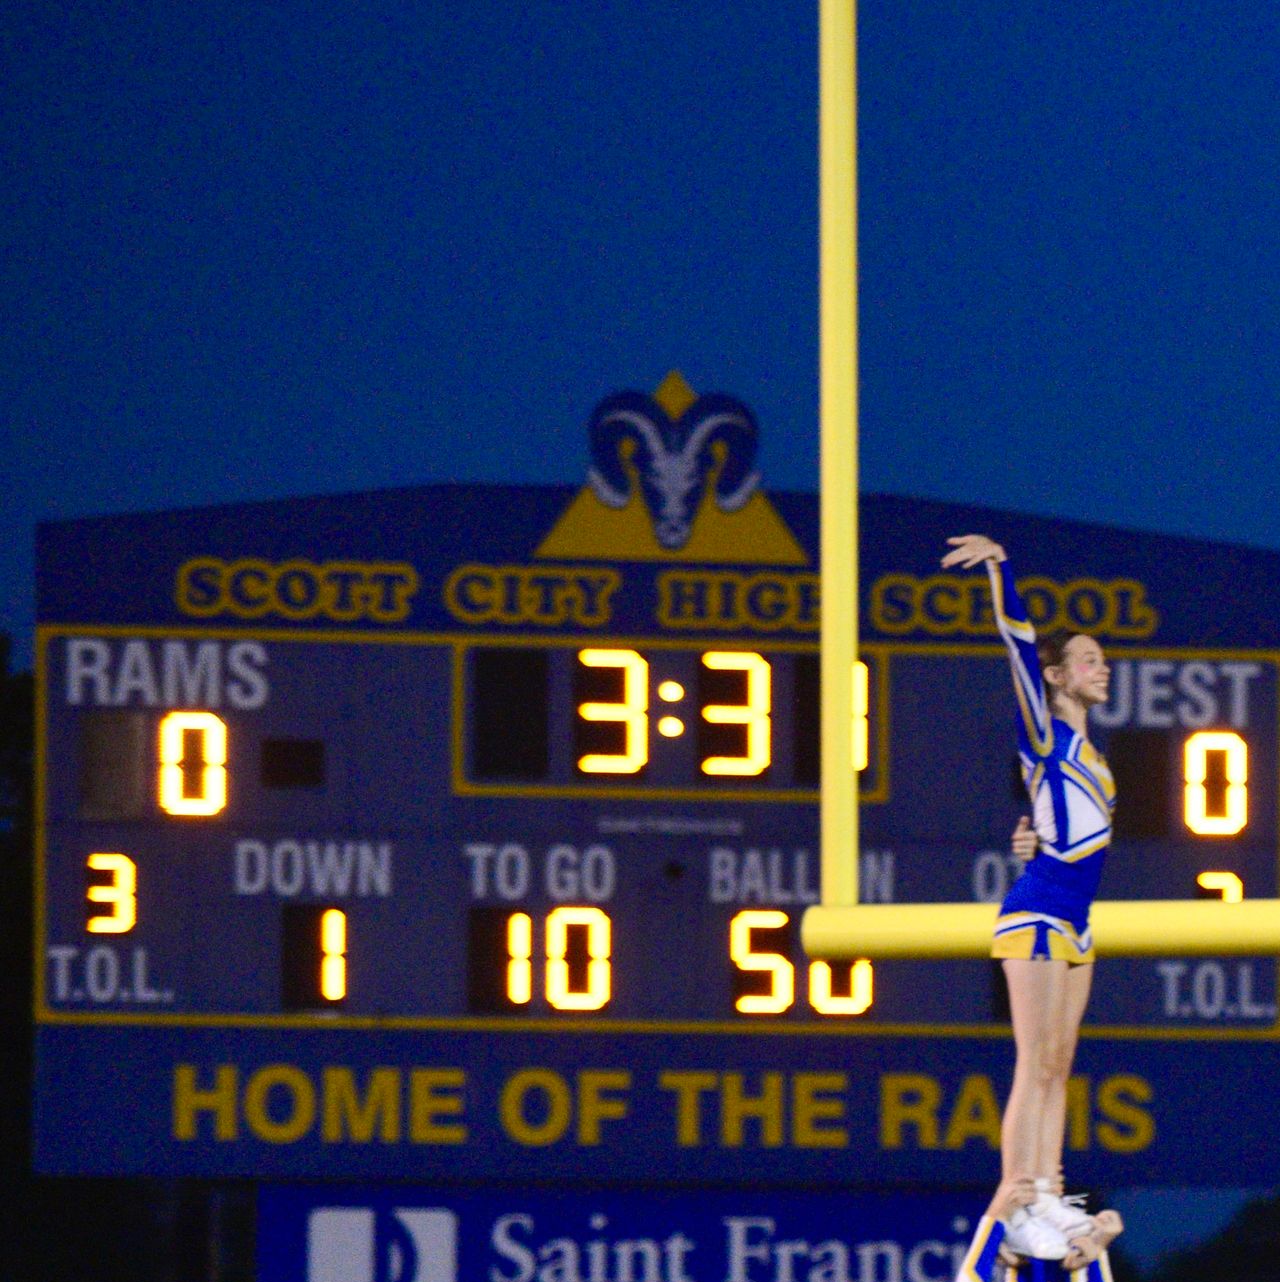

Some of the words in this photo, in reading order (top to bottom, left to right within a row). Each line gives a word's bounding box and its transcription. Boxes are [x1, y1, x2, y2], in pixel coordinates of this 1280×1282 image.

[177, 558, 417, 620] SCOTT
[444, 565, 620, 625] CITY
[66, 639, 269, 709] RAMS
[1091, 660, 1261, 729] UEST
[578, 649, 868, 776] 3:31
[160, 711, 227, 816] 0
[1184, 731, 1248, 835] 0
[86, 853, 137, 933] 3
[233, 842, 393, 896] DOWN
[463, 844, 531, 899] TO
[545, 846, 617, 902] GO
[710, 848, 821, 903] BALL
[49, 947, 175, 1003] T.O.L.
[321, 908, 347, 1000] 1
[507, 907, 612, 1011] 10
[1155, 963, 1276, 1018] T.O.L.
[172, 1064, 468, 1144] HOME
[500, 1069, 631, 1147] OF
[658, 1071, 849, 1149] THE
